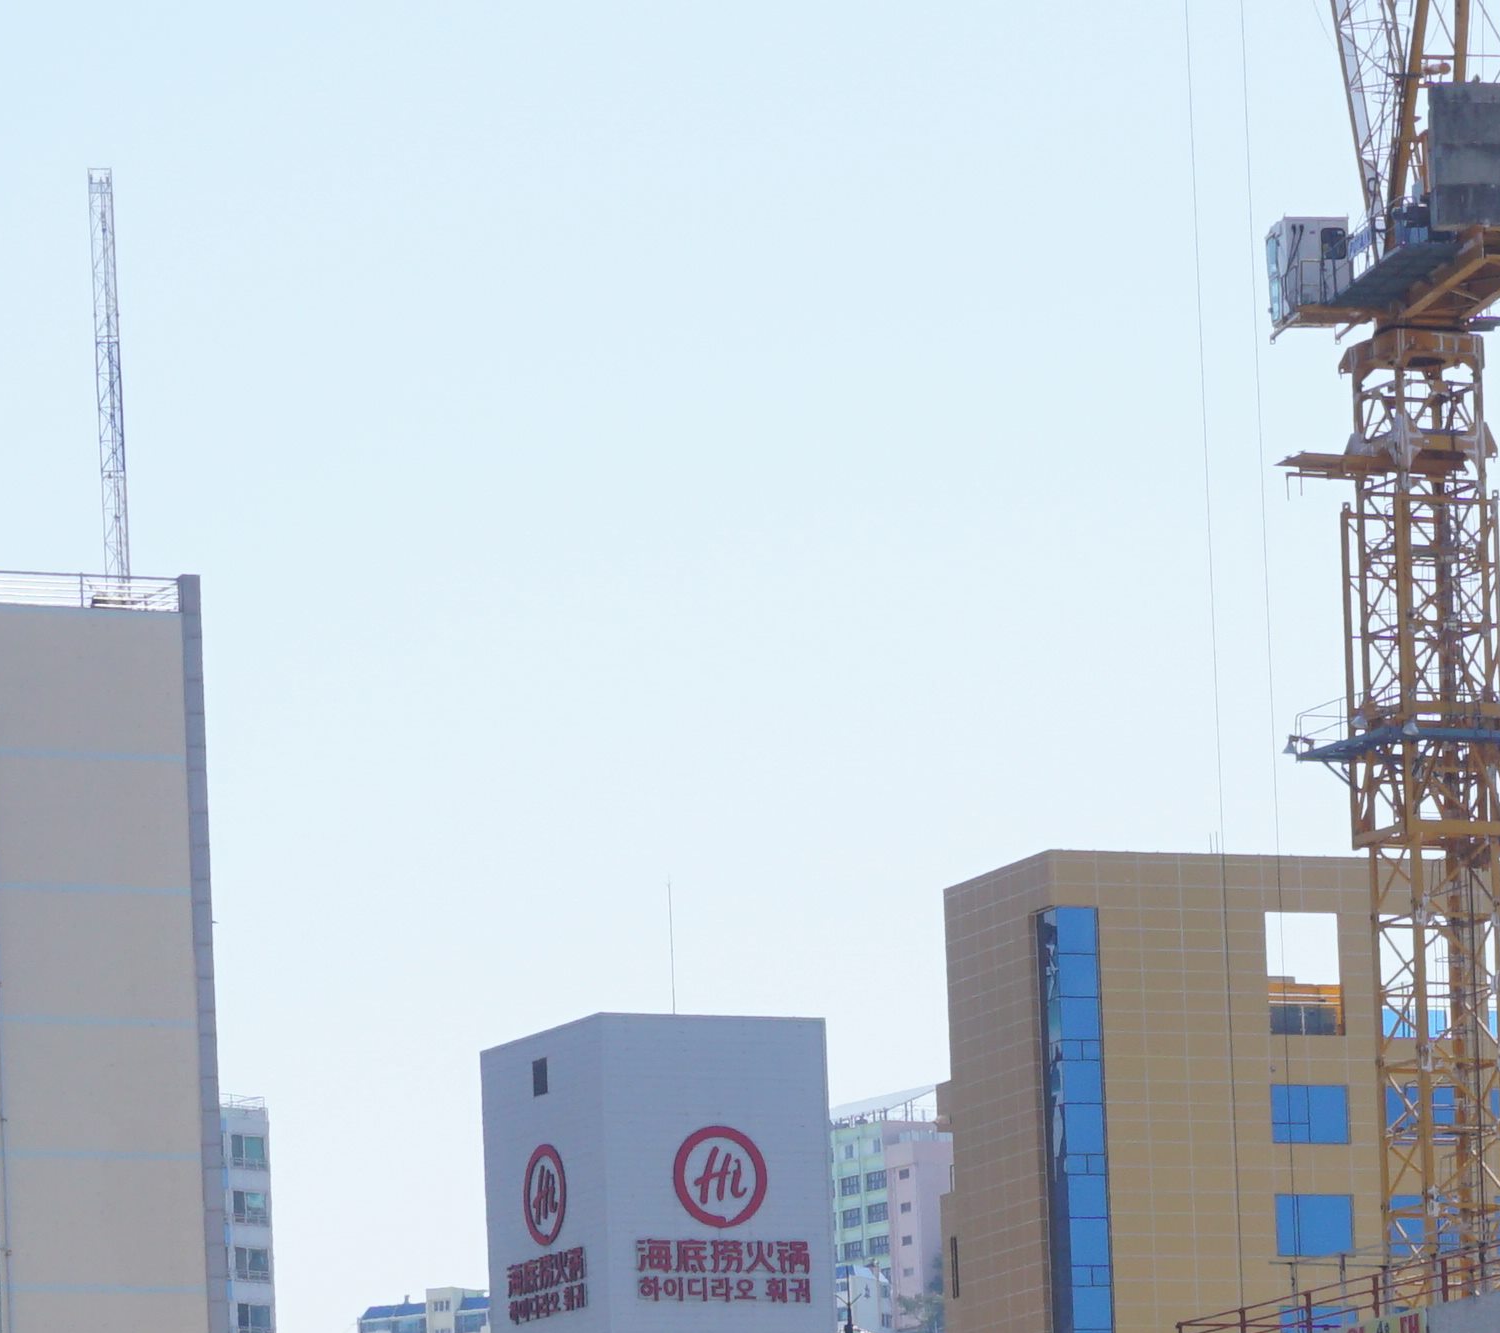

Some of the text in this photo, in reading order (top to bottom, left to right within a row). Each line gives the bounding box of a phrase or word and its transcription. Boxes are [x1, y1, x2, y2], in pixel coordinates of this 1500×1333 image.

[693, 1146, 748, 1205] Hi
[636, 1239, 811, 1274] 海底捞火锅
[638, 1276, 757, 1301] 하이디라오
